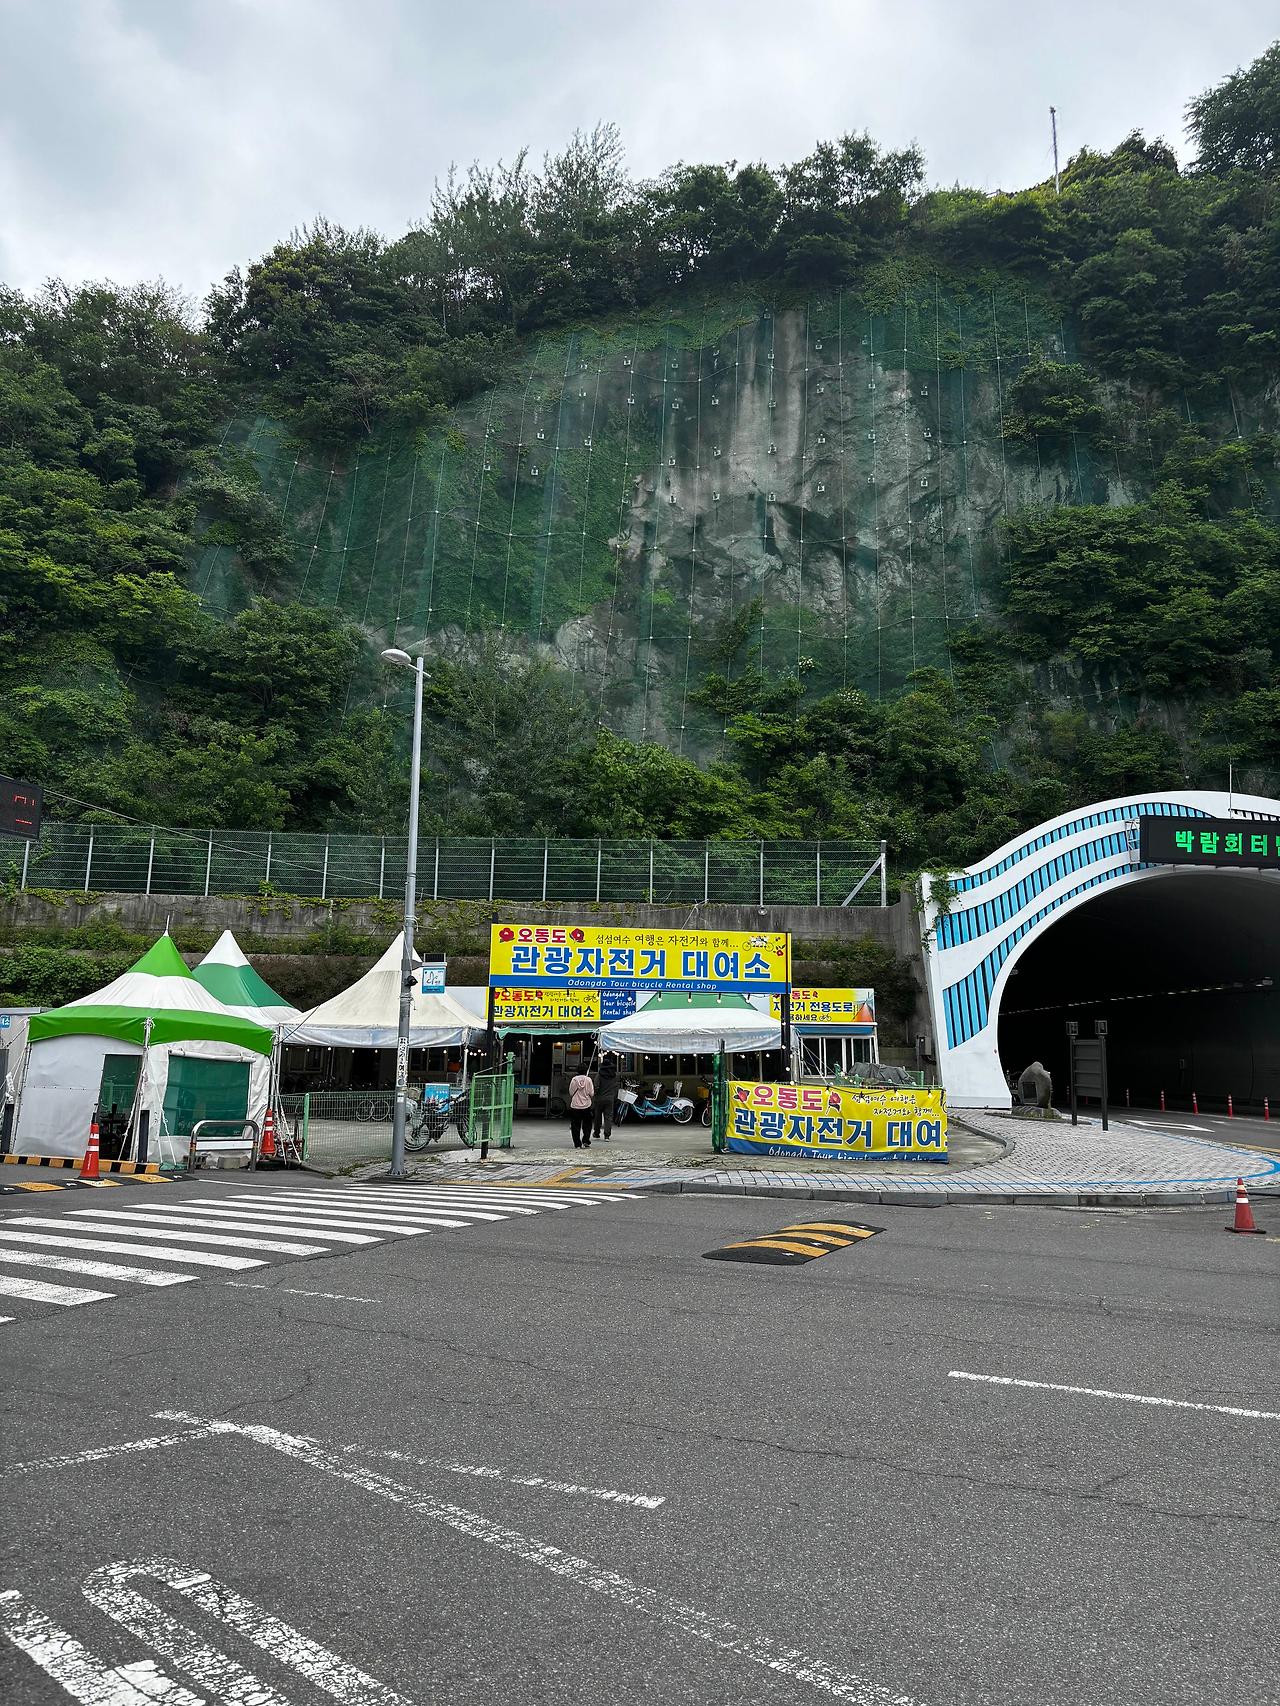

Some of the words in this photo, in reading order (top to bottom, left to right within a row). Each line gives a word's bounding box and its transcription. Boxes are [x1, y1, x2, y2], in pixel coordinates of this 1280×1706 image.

[517, 928, 567, 943] 오동도
[595, 933, 631, 945] 섬섬여수
[634, 933, 665, 946] 여행은
[667, 934, 708, 947] 자전거와
[511, 946, 666, 977] 관광자전거
[682, 951, 771, 979] 대여소
[567, 979, 607, 988] Odongdo
[631, 980, 663, 990] bicycle
[665, 981, 694, 990] Rental
[696, 983, 717, 991] shop
[501, 990, 536, 1002] 오동도
[602, 991, 625, 1000] Odongdo
[494, 1005, 553, 1018] 관광자전거
[558, 1005, 595, 1018] 대여소
[602, 1008, 621, 1016] Rental
[809, 1001, 853, 1013] 전용도로
[753, 1085, 823, 1111] 오동도
[735, 1107, 872, 1148] 관광자전거
